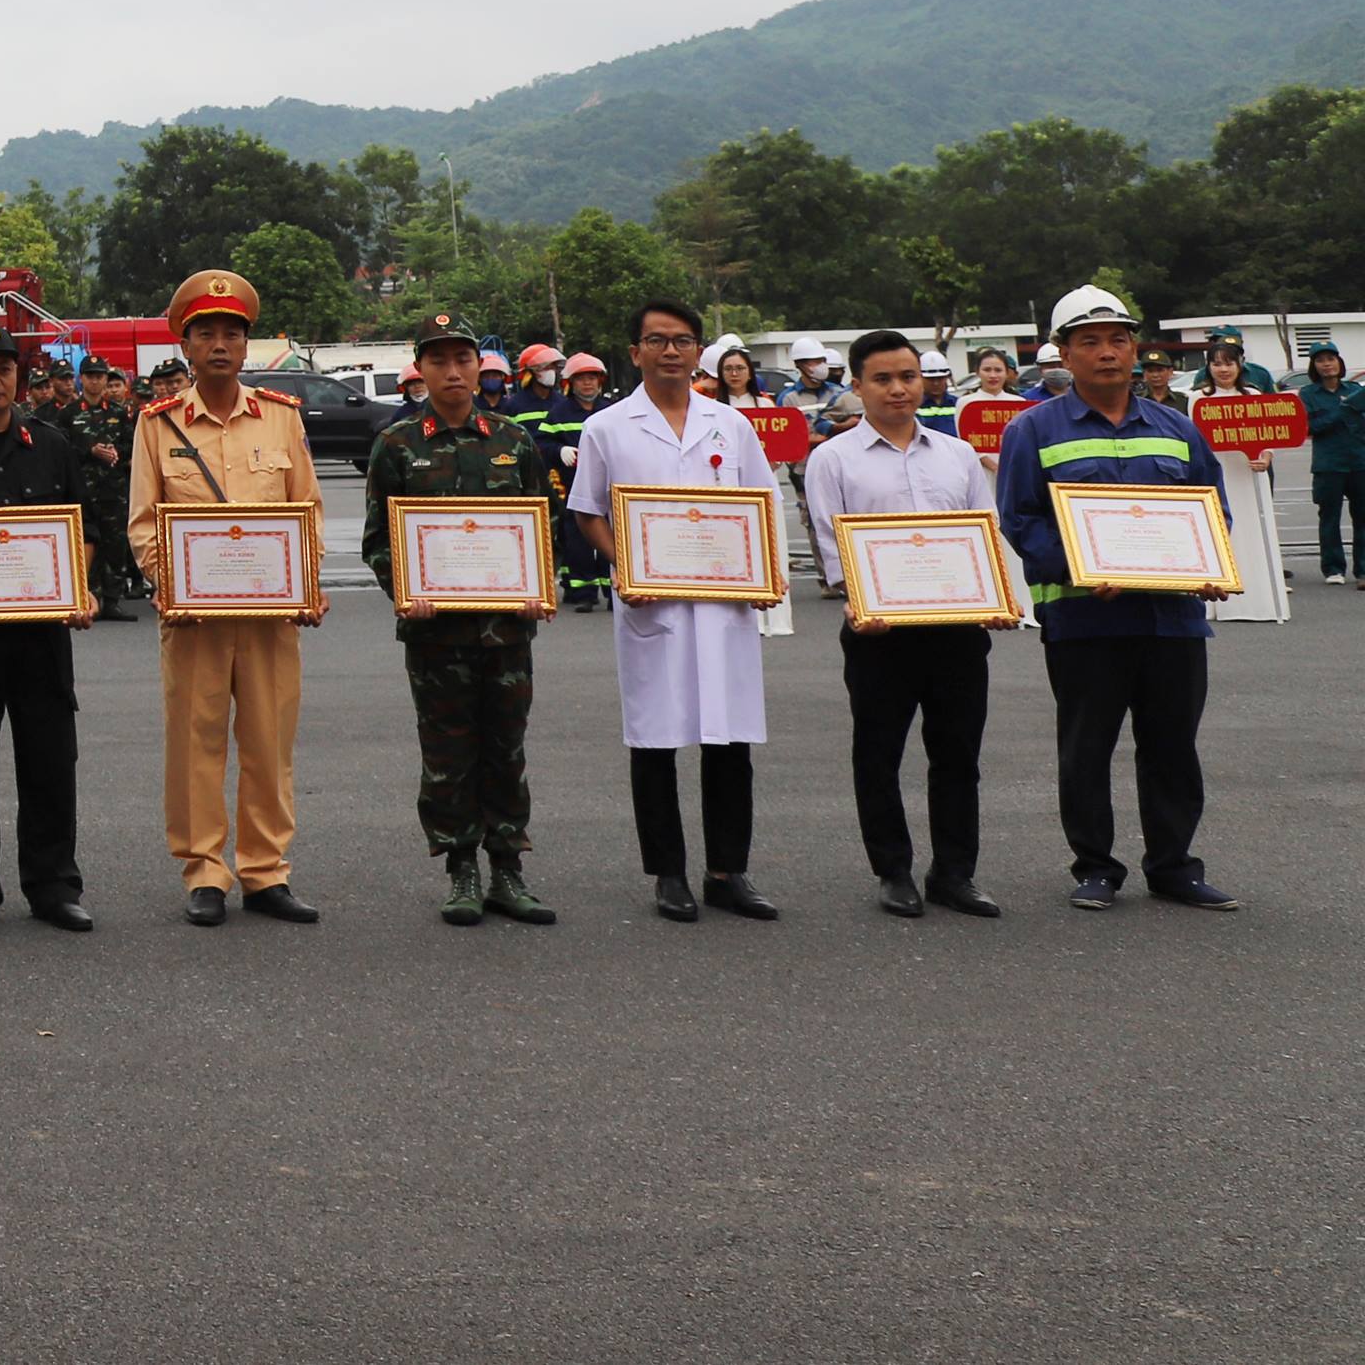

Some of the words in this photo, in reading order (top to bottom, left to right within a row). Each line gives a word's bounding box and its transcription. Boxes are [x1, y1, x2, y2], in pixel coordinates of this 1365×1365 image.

[1200, 403, 1222, 421] CÔNG
[1223, 405, 1232, 419] TY
[1233, 404, 1245, 419] CP
[1245, 400, 1263, 418] MÔI
[1263, 398, 1297, 417] TRƯỜNG
[752, 417, 767, 432] TY
[771, 417, 789, 432] CP
[1238, 422, 1258, 442] TỈNH
[1258, 423, 1274, 441] LÀO
[1275, 425, 1290, 440] CAI
